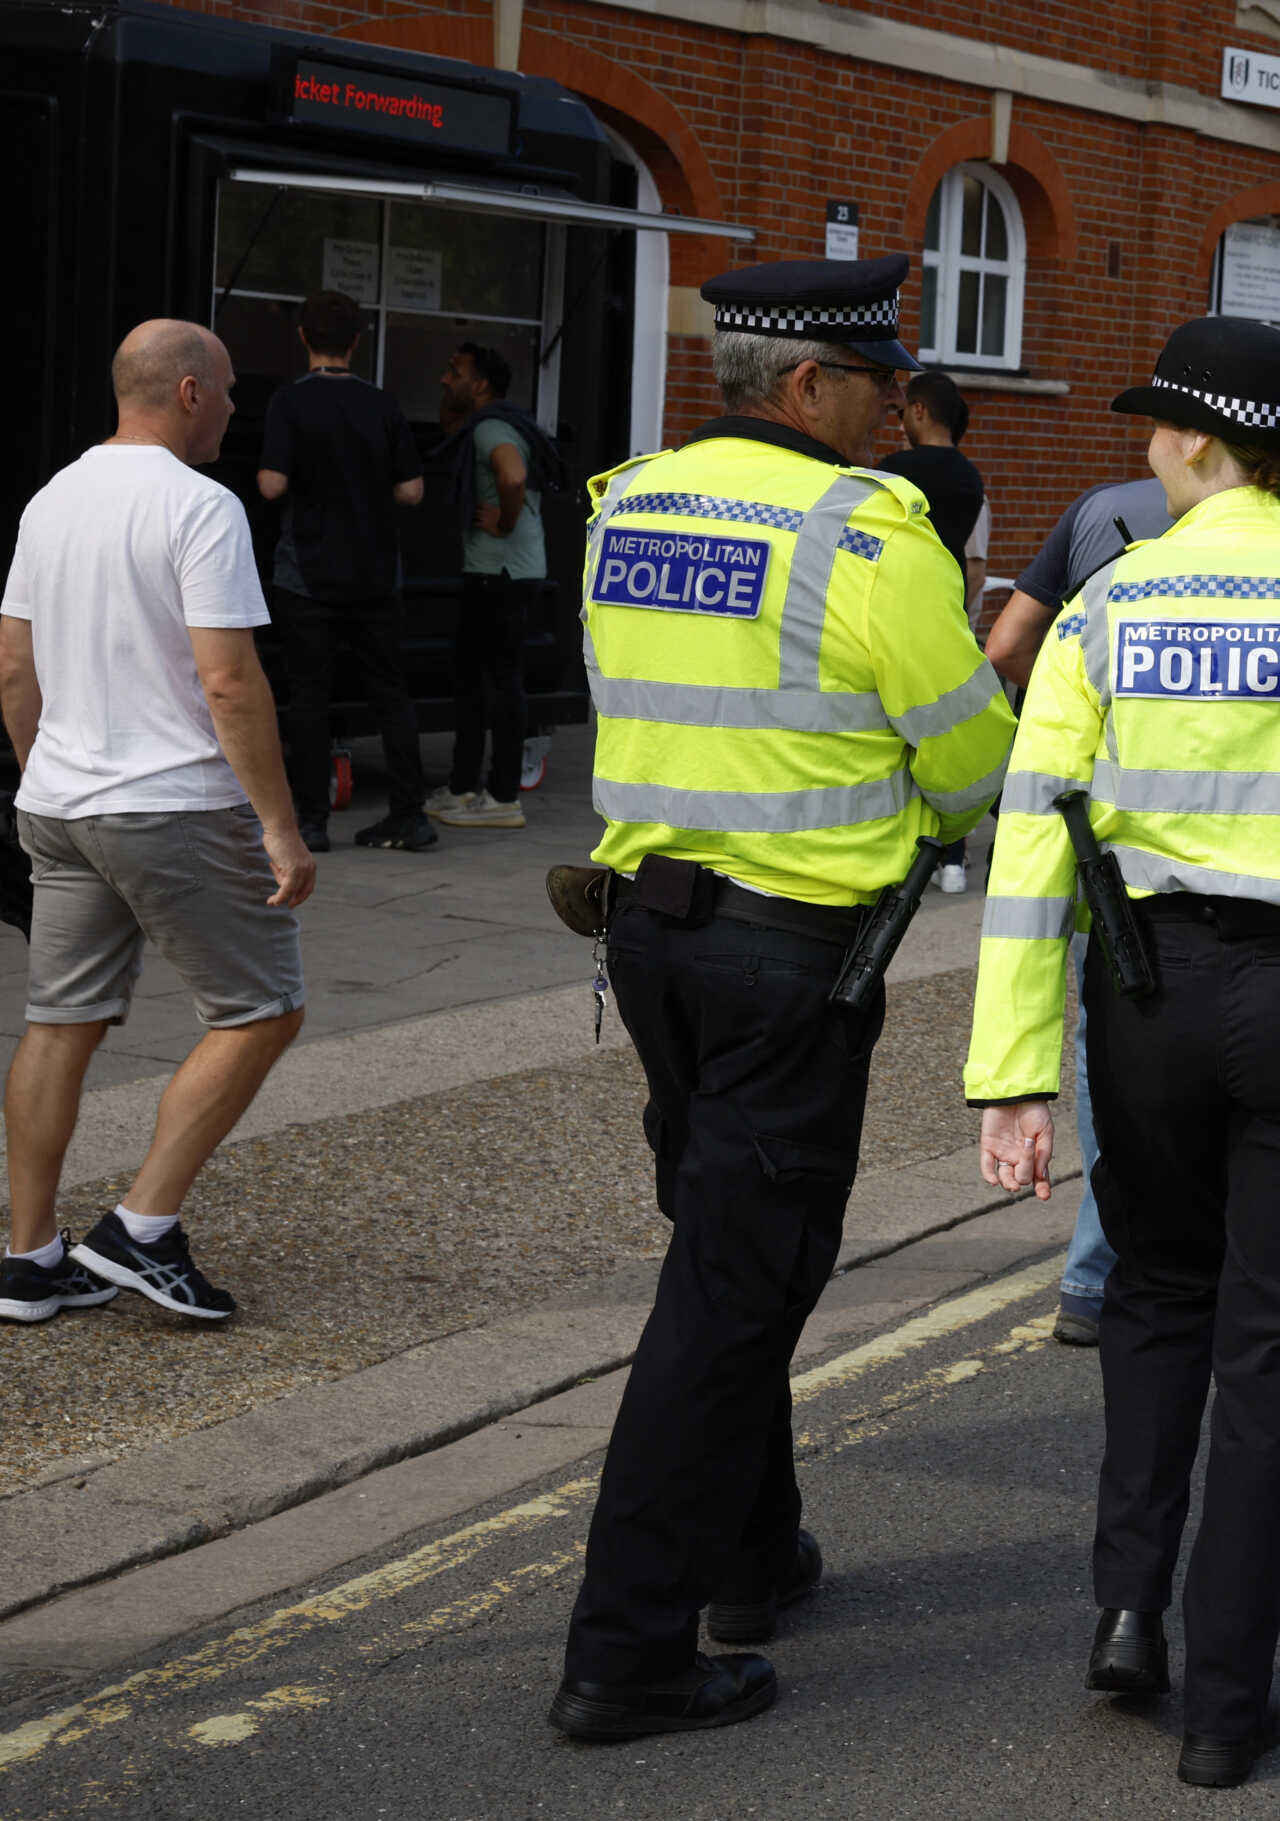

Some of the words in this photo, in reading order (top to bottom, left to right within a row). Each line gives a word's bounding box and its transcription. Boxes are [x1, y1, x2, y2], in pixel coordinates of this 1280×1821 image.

[295, 74, 340, 104] icket
[344, 83, 443, 128] Forwarding
[609, 536, 761, 566] METROPOLITAN
[600, 559, 757, 608] POLICE
